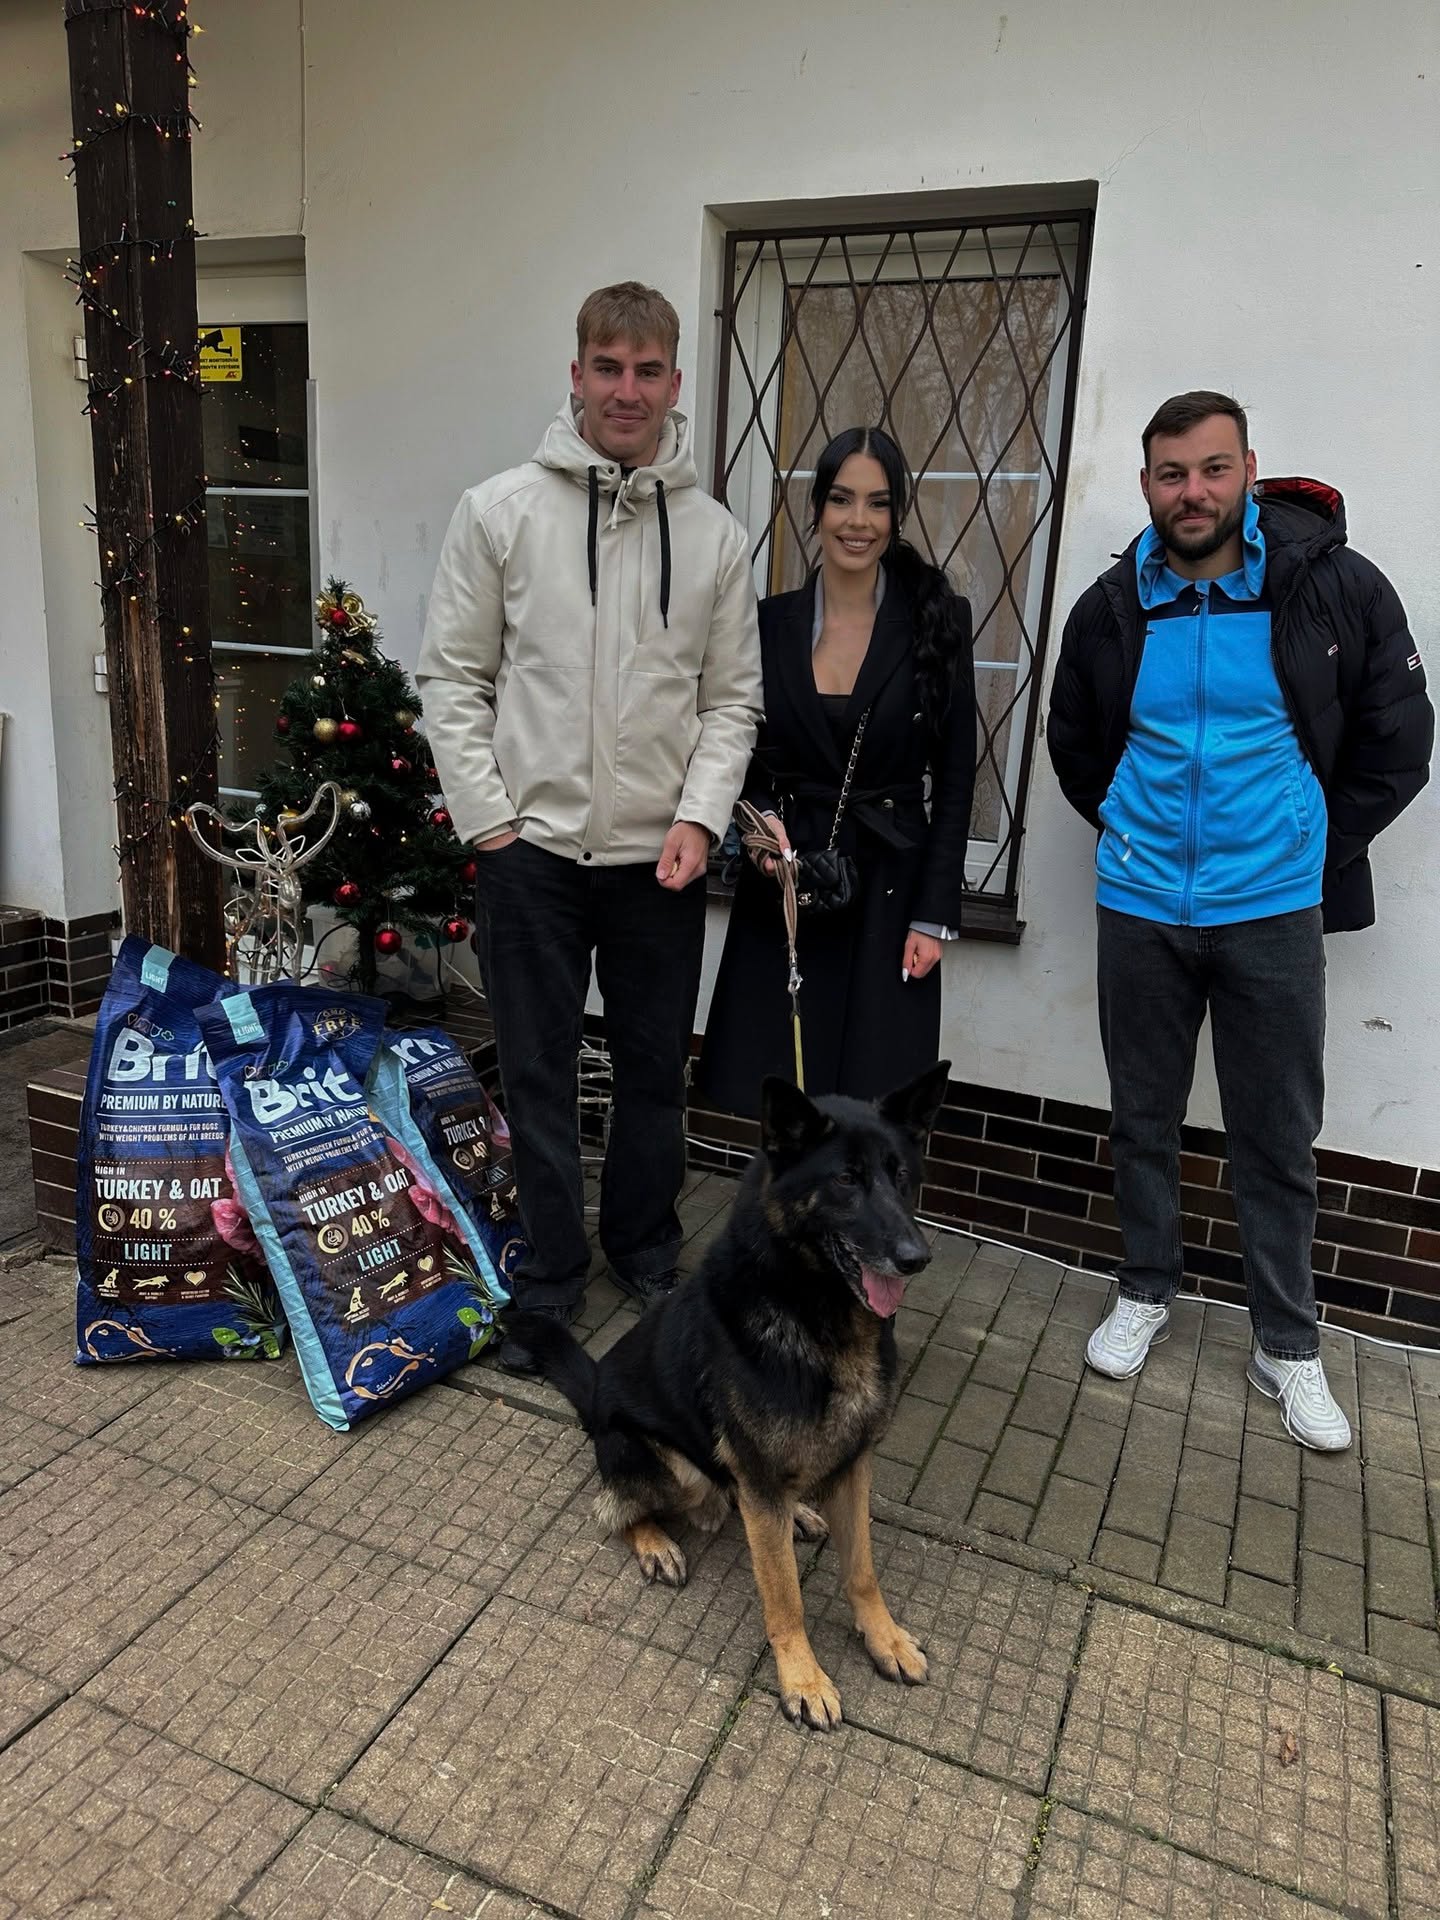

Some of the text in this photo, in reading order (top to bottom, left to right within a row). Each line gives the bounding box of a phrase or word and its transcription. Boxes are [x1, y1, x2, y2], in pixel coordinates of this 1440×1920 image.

[145, 971, 165, 985] LIGHT
[100, 1094, 159, 1110] PREMIUM
[162, 1095, 179, 1110] BY
[243, 1067, 362, 1124] Brit
[158, 1124, 188, 1132] FORMULA
[189, 1123, 200, 1131] FOR
[268, 1116, 326, 1143] PREMIUM
[335, 1106, 369, 1124] NATUR
[443, 1118, 480, 1145] TURKEY
[99, 1132, 114, 1142] WITH
[115, 1133, 141, 1142] WEIGHT
[143, 1133, 177, 1142] PROBLEMS
[178, 1133, 187, 1141] OF
[188, 1132, 199, 1141] ALL
[94, 1165, 125, 1175] HIGH IN
[286, 1160, 304, 1173] WITH
[304, 1154, 326, 1166] WEIGHT
[95, 1178, 222, 1200] TURKEY & OAT
[299, 1186, 327, 1204] HIGH IN
[302, 1168, 409, 1225] TURKEY & OAT
[129, 1207, 177, 1230] 40 %
[351, 1208, 390, 1237] 40 %
[124, 1243, 172, 1261] LIGHT
[357, 1238, 402, 1271] LIGHT
